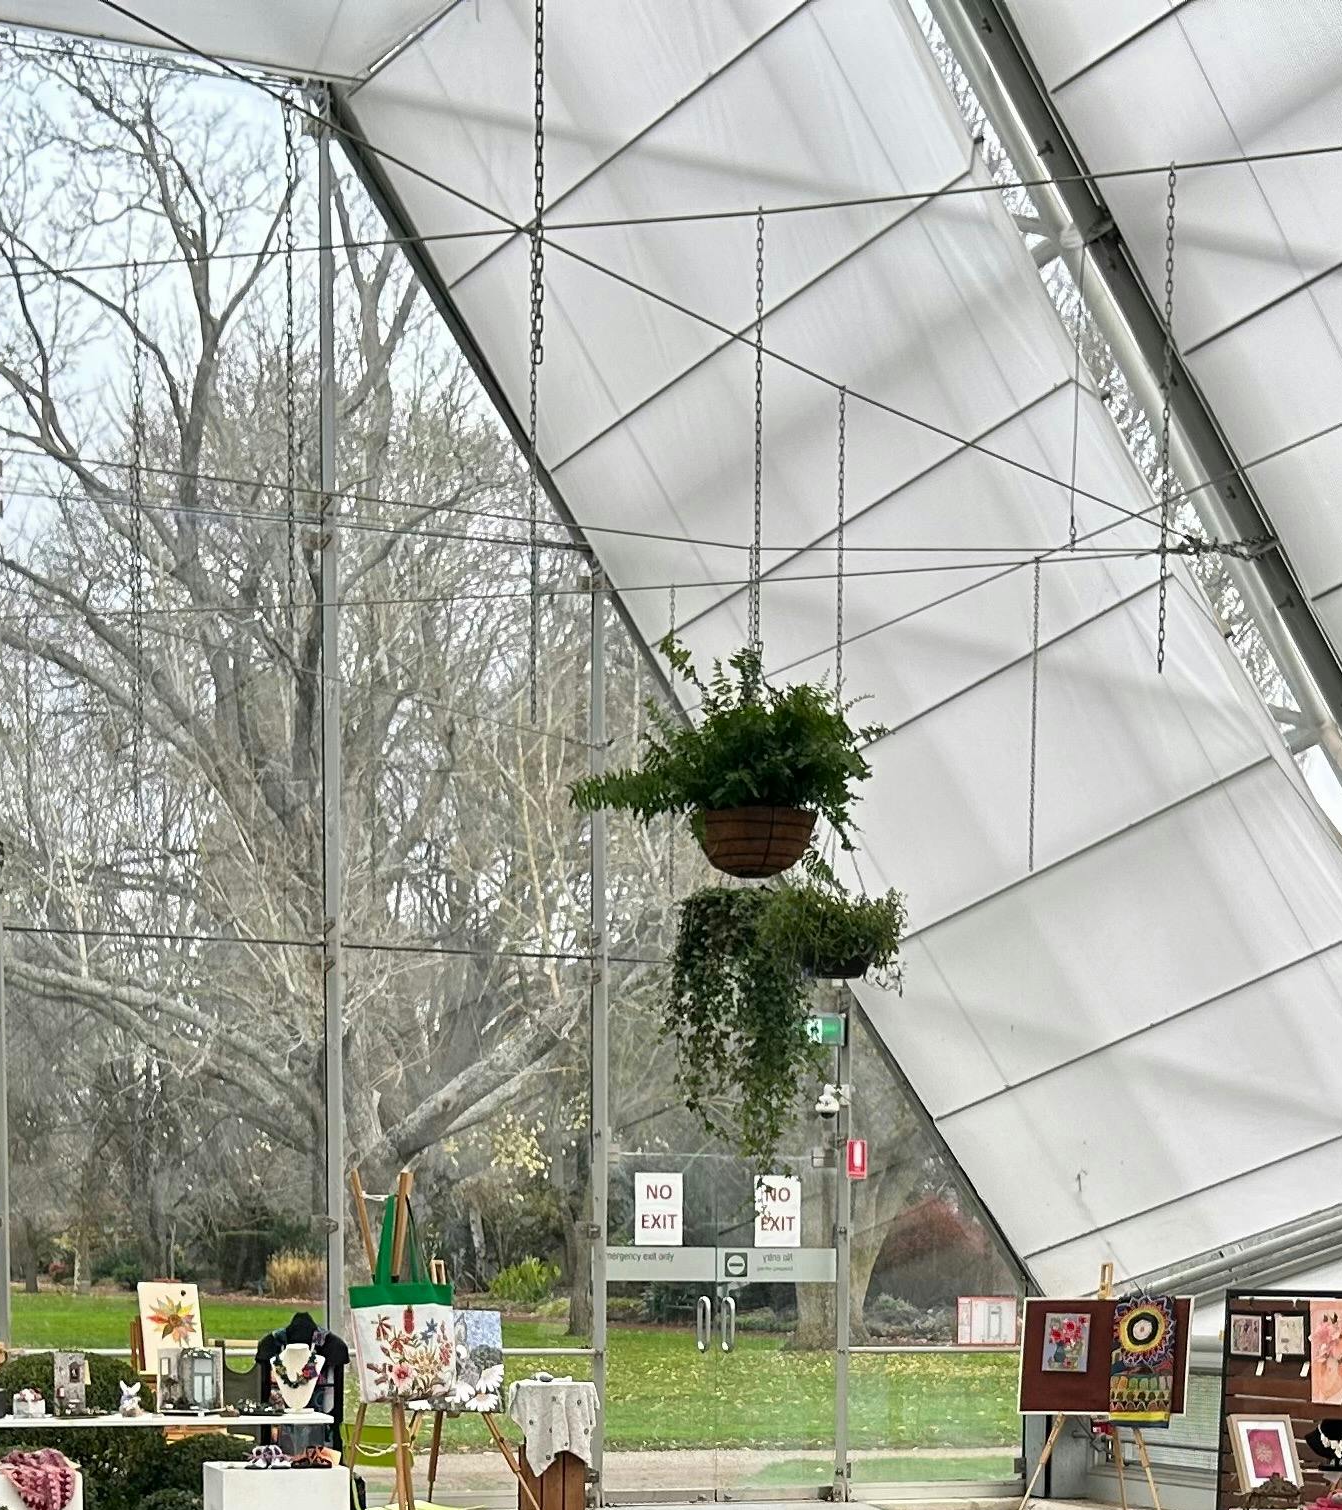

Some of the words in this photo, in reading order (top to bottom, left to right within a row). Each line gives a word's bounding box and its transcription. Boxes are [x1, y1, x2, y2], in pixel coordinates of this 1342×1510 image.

[646, 1184, 672, 1200] NO
[765, 1187, 791, 1202] NO
[641, 1214, 678, 1229] EXIT
[760, 1216, 796, 1231] EXIT
[606, 1252, 641, 1262] mergency
